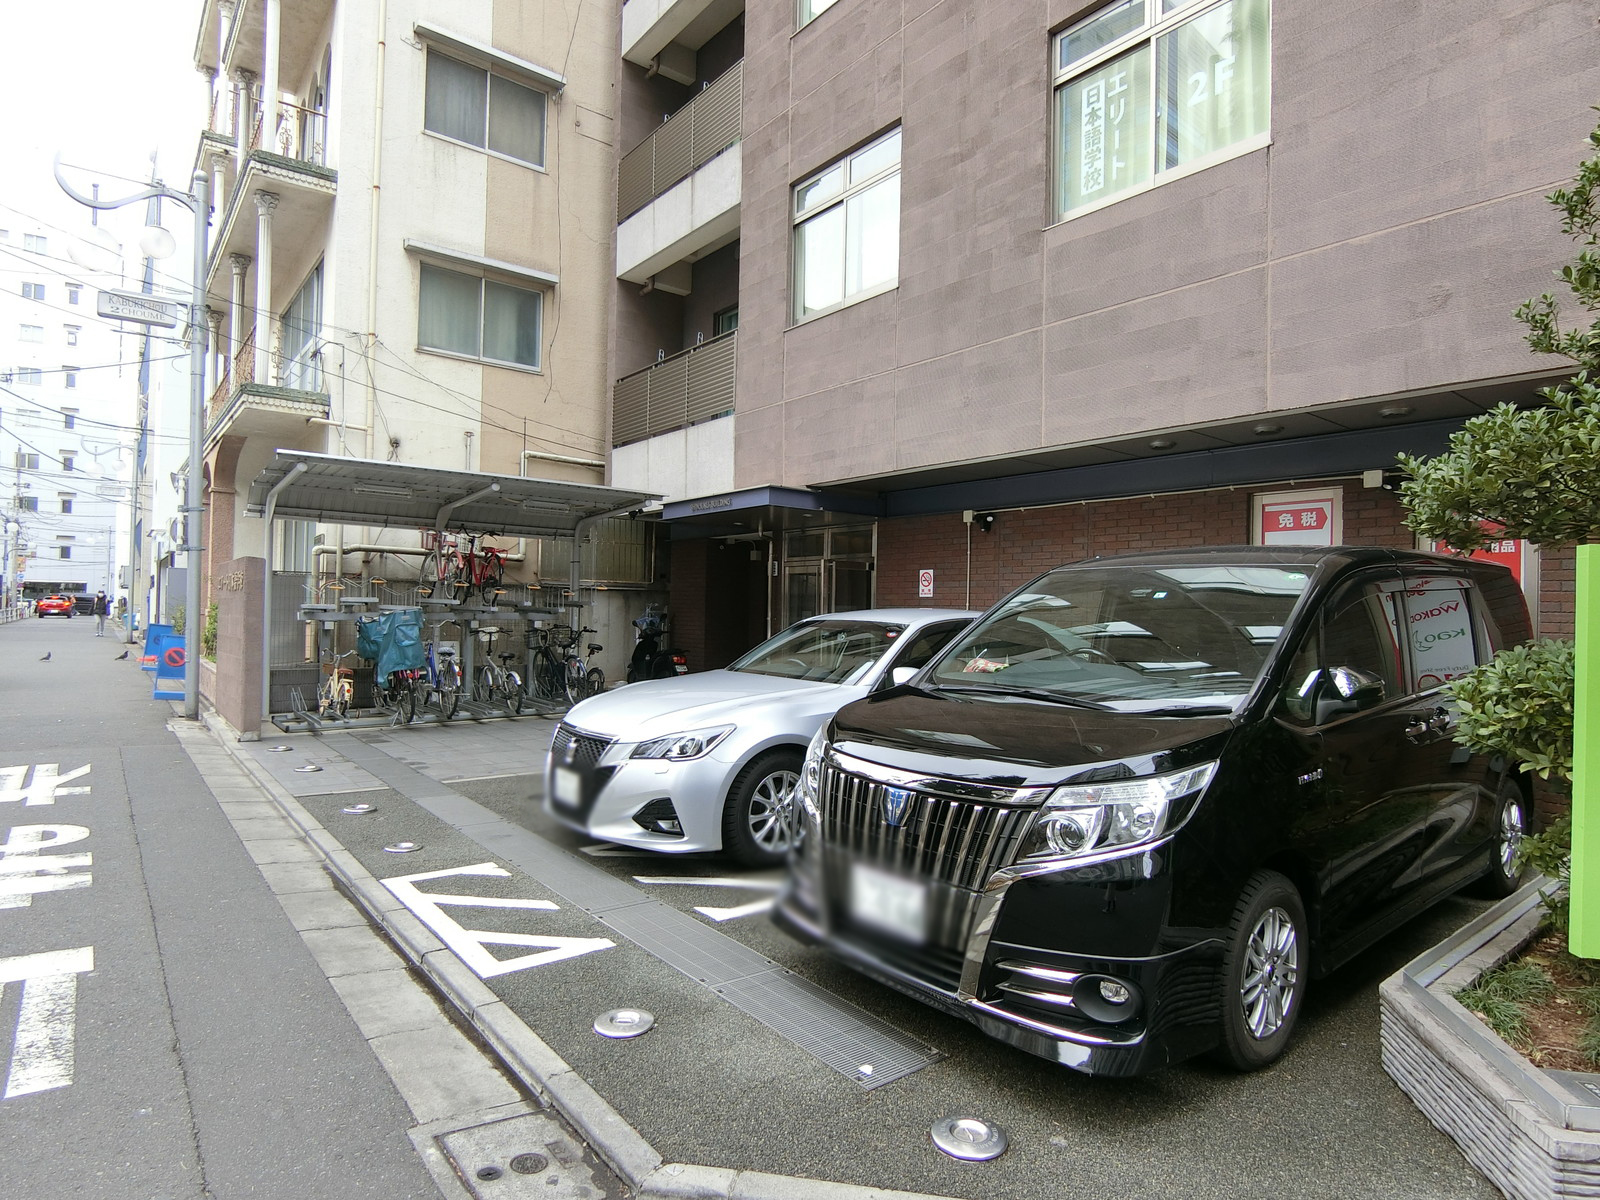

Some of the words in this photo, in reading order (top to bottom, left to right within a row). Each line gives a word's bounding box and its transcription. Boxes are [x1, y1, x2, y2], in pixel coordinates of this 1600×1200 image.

[1187, 55, 1236, 108] 2F
[1082, 82, 1103, 192] 日本語学校
[1107, 71, 1128, 181] エリート
[108, 295, 168, 313] KABUKICHOU
[121, 307, 166, 321] CHOUME
[1278, 511, 1317, 529] 免税
